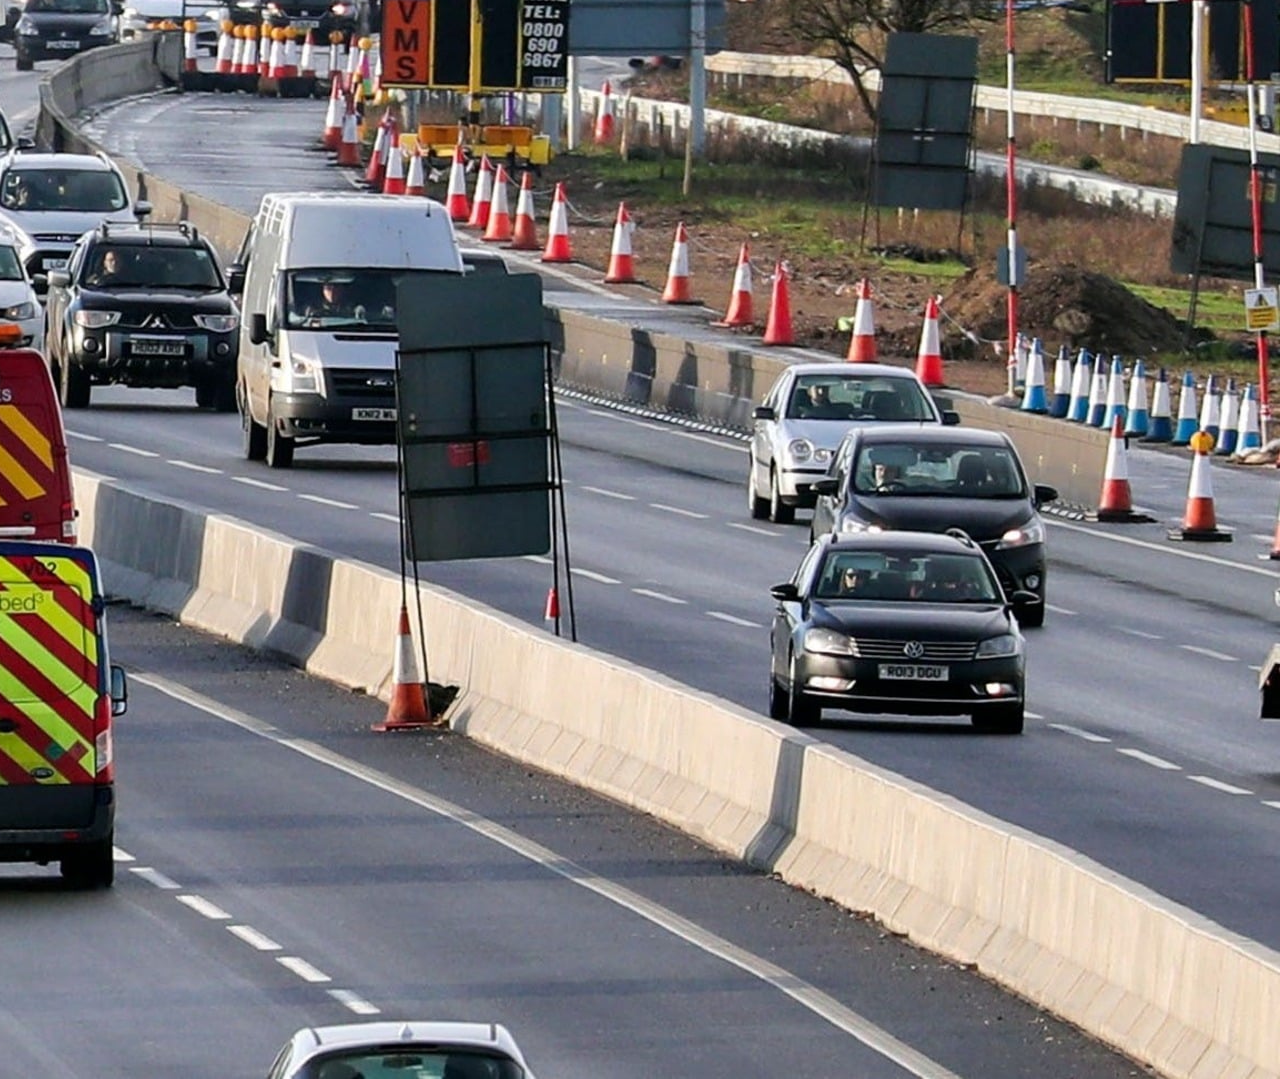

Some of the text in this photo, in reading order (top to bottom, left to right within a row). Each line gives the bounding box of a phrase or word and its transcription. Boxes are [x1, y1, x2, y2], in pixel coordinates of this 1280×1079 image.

[524, 5, 561, 18] TEL:
[523, 22, 564, 37] 0800
[527, 38, 558, 52] 690
